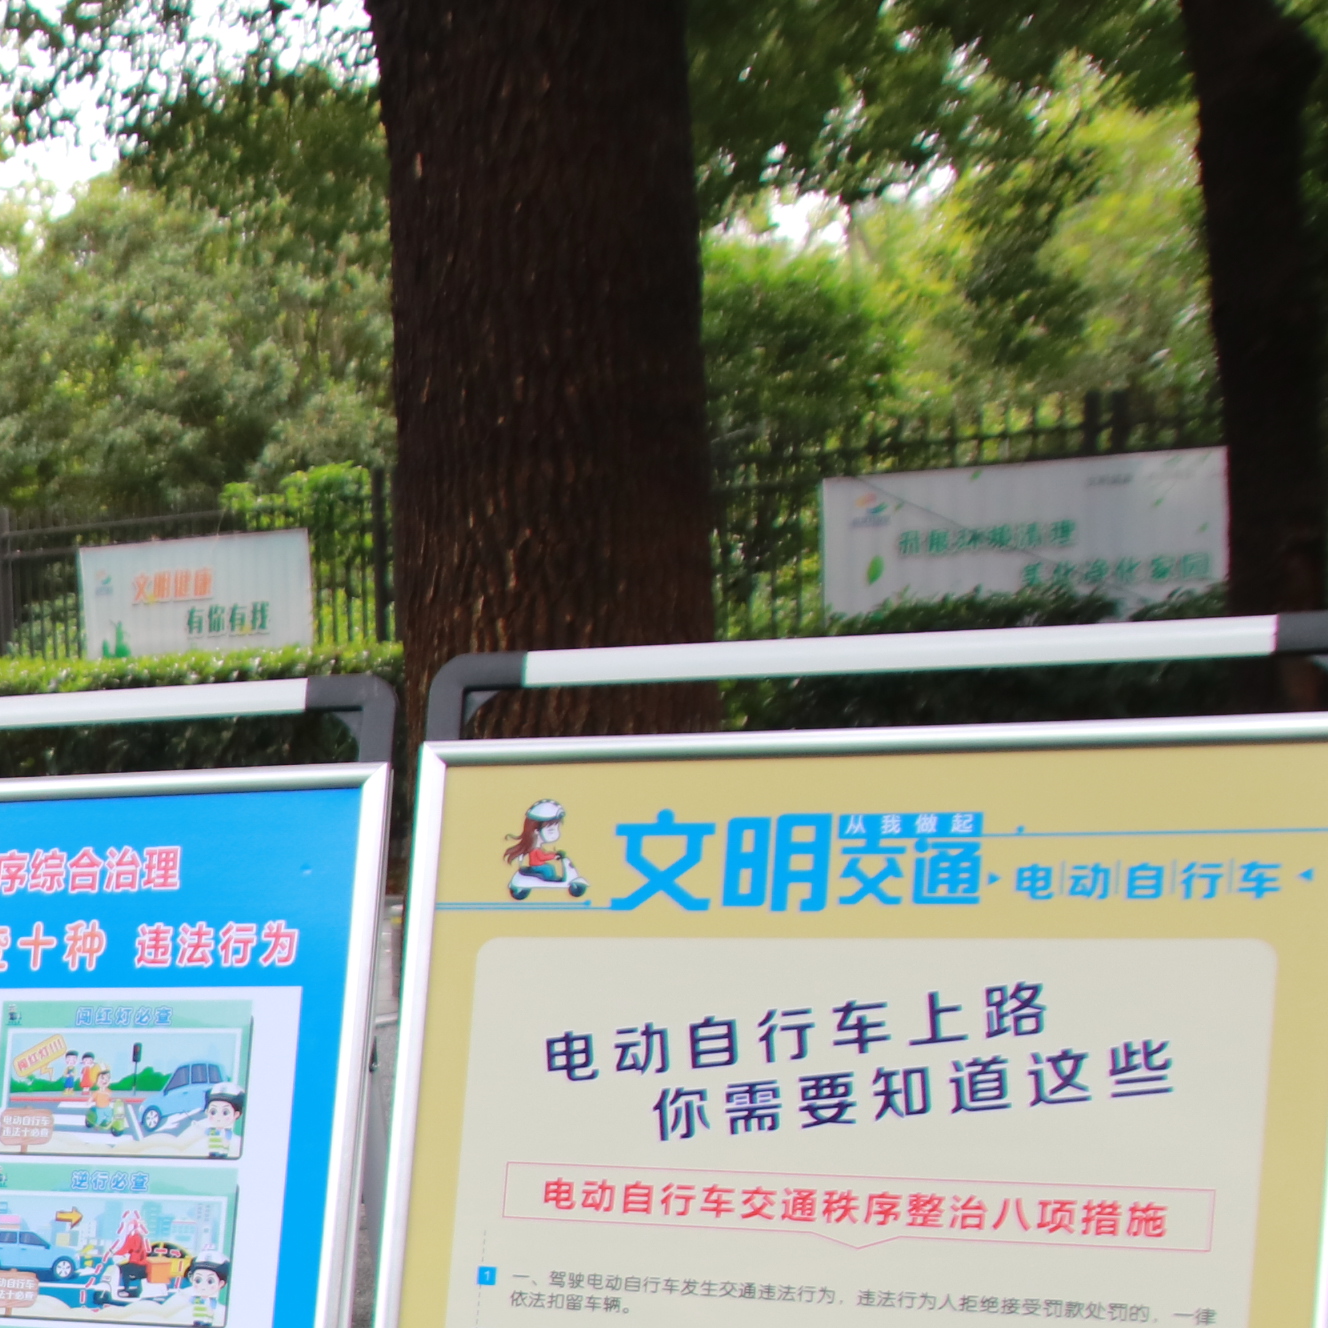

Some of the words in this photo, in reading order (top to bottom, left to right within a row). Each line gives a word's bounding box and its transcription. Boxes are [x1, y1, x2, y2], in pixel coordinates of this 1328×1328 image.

[132, 567, 213, 603] 文明健康
[187, 601, 270, 633] 有你有我
[840, 811, 976, 837] 从我做起
[611, 809, 834, 913] 文明
[838, 840, 983, 907] 交通
[135, 920, 299, 969] 违法行为
[75, 1005, 173, 1026] 闯红灯必查
[545, 981, 1048, 1082] 电动自行车上路
[653, 1038, 1176, 1143] 你需要知道这些
[2, 1115, 50, 1126] 电动自行车
[71, 1170, 150, 1191] 逆行必查
[542, 1176, 1169, 1240] 电动自行车交通秩序整治八项措施
[483, 1271, 491, 1281] 1
[510, 1290, 632, 1315] 依法扣留车辆。
